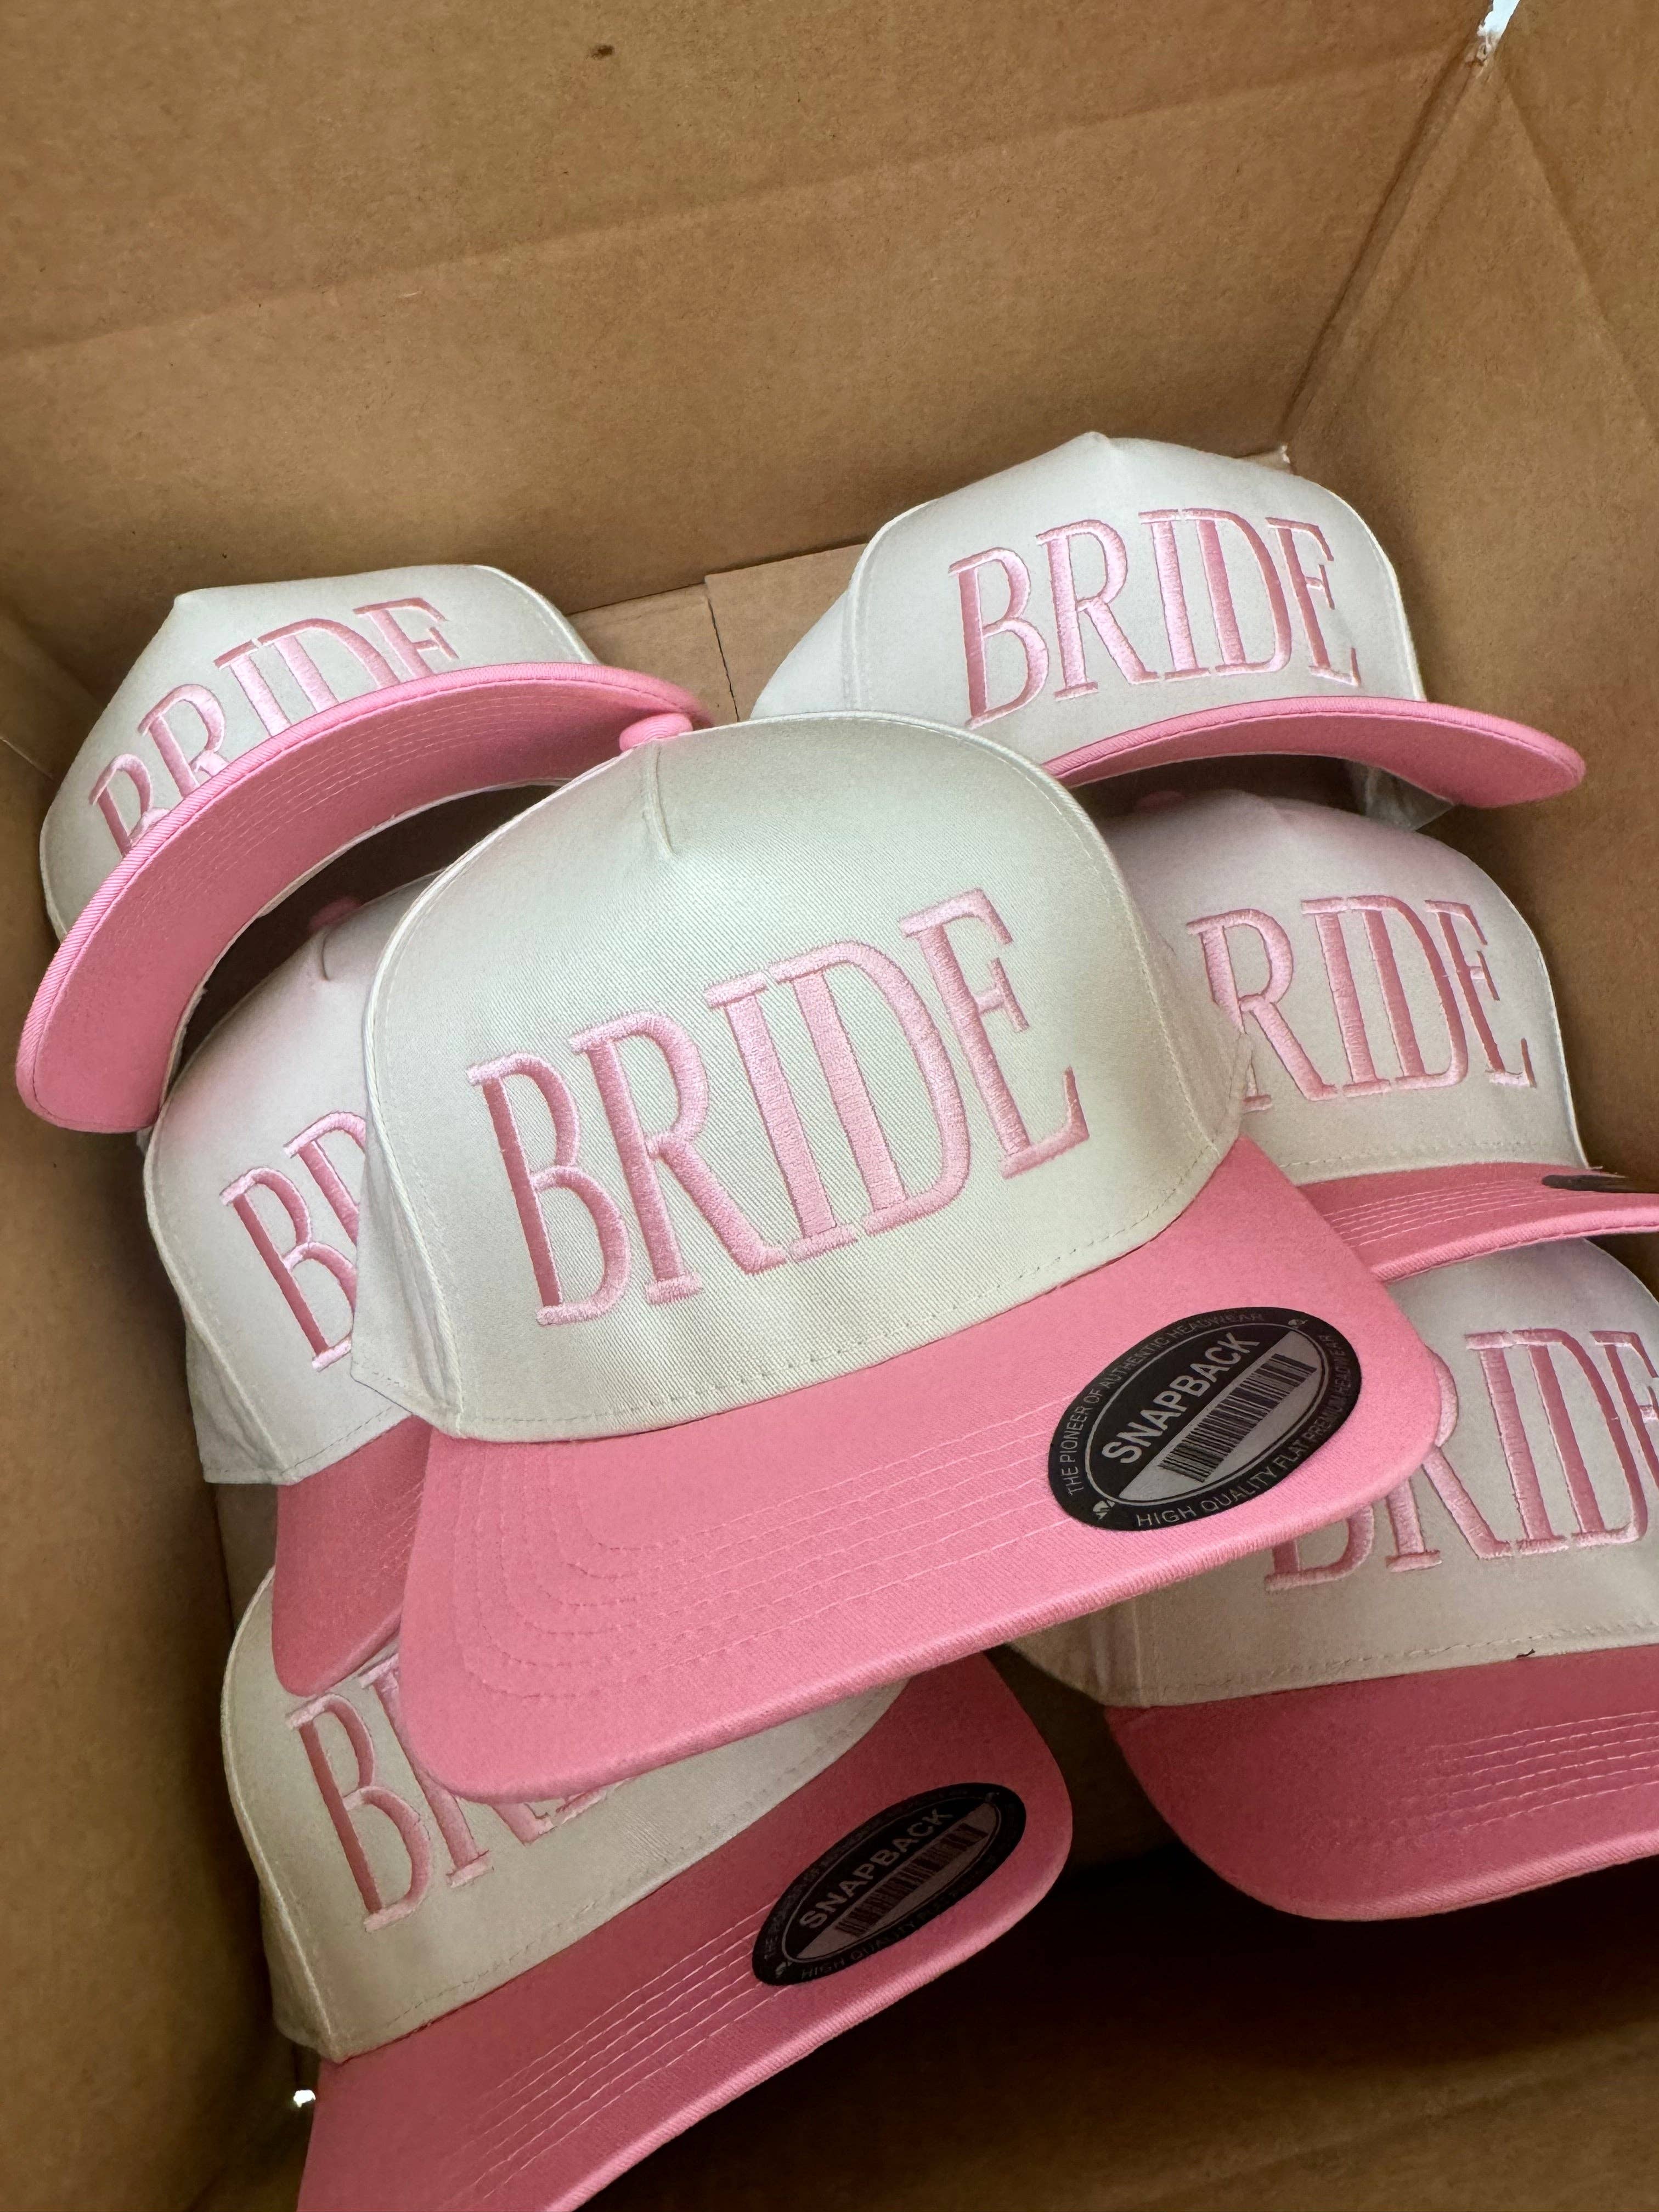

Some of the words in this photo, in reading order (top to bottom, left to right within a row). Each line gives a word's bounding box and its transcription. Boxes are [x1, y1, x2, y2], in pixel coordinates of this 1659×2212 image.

[948, 507, 1362, 730] BRIDE
[1186, 895, 1537, 1103] RIDE
[466, 887, 1090, 1326] BRIDE
[1082, 1389, 1102, 1404] OF
[1100, 1337, 1170, 1390] AUTHENTIC
[1102, 1331, 1260, 1464] SNAPBACK
[1059, 1406, 1093, 1463] PIONEER
[1062, 1466, 1084, 1496] THE
[1136, 1505, 1197, 1527] HIGH
[1200, 1465, 1278, 1512] QUALITY
[1274, 1438, 1310, 1471] FLAT
[799, 1808, 952, 1929] SNAPBACK
